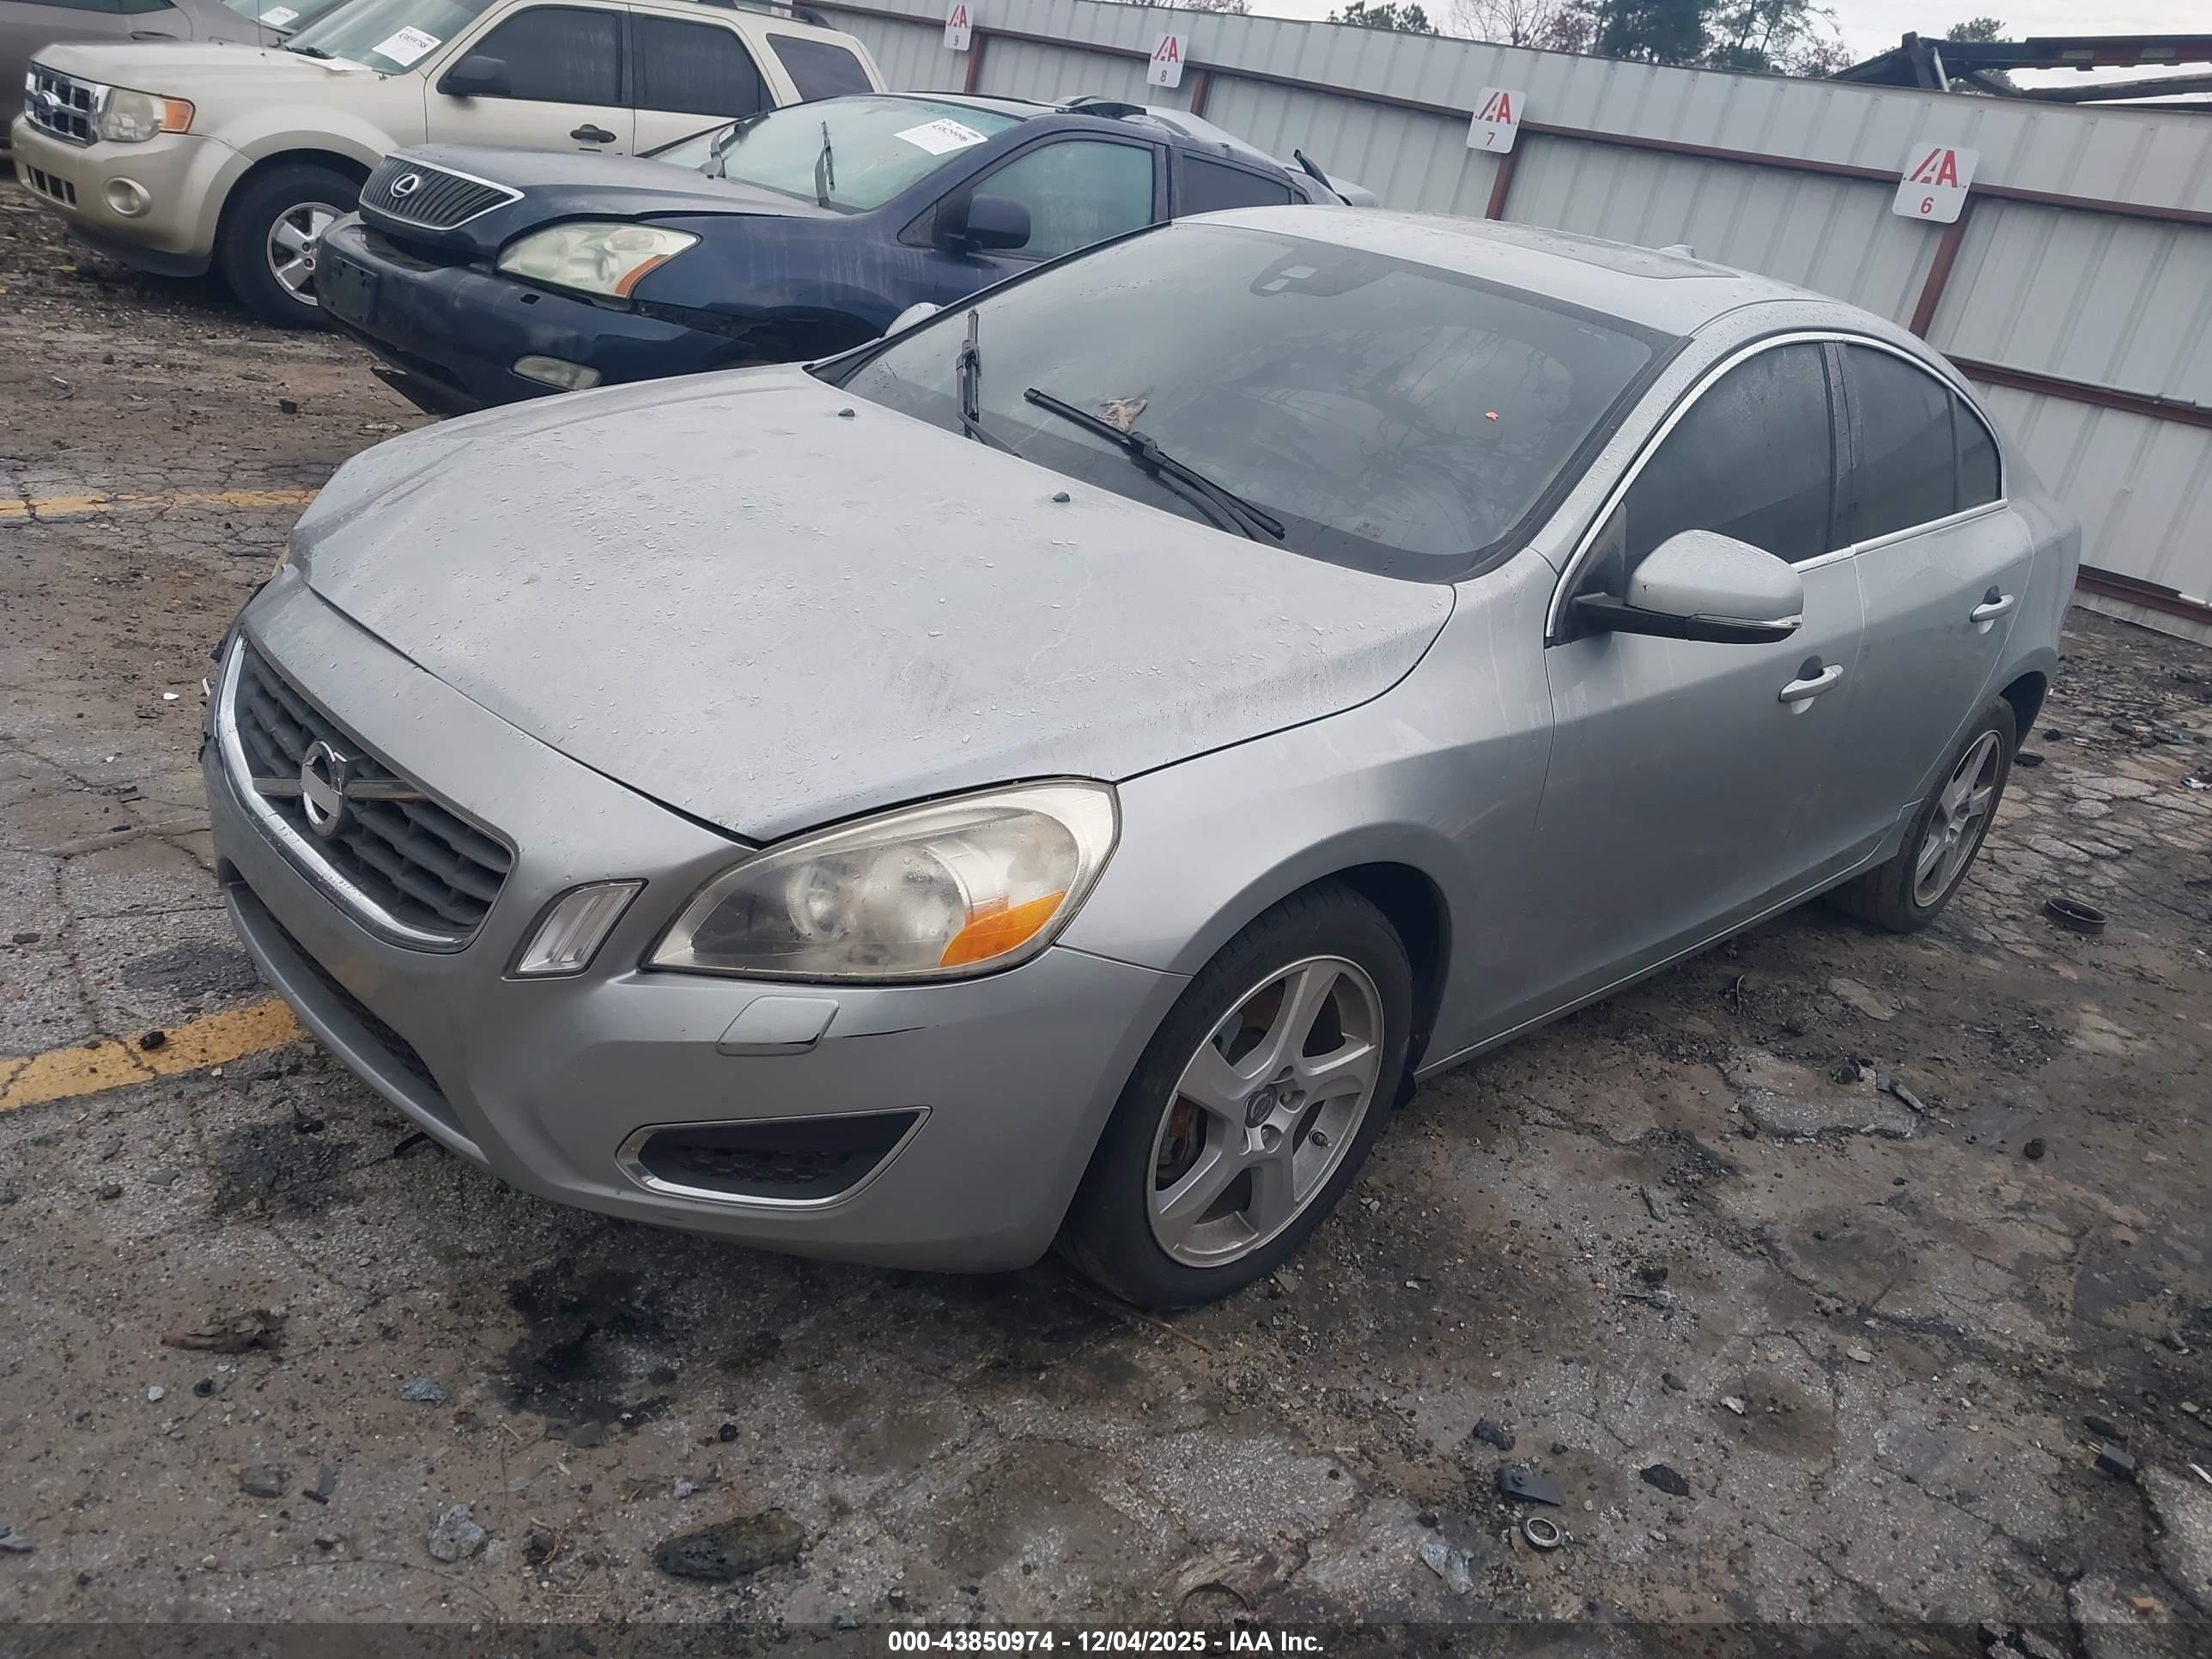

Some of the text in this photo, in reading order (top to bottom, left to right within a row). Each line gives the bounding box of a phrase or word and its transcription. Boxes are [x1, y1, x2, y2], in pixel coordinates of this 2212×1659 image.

[954, 34, 960, 46] 9
[1159, 70, 1168, 83] 8
[1486, 131, 1496, 147] 7
[1920, 196, 1935, 215] 6
